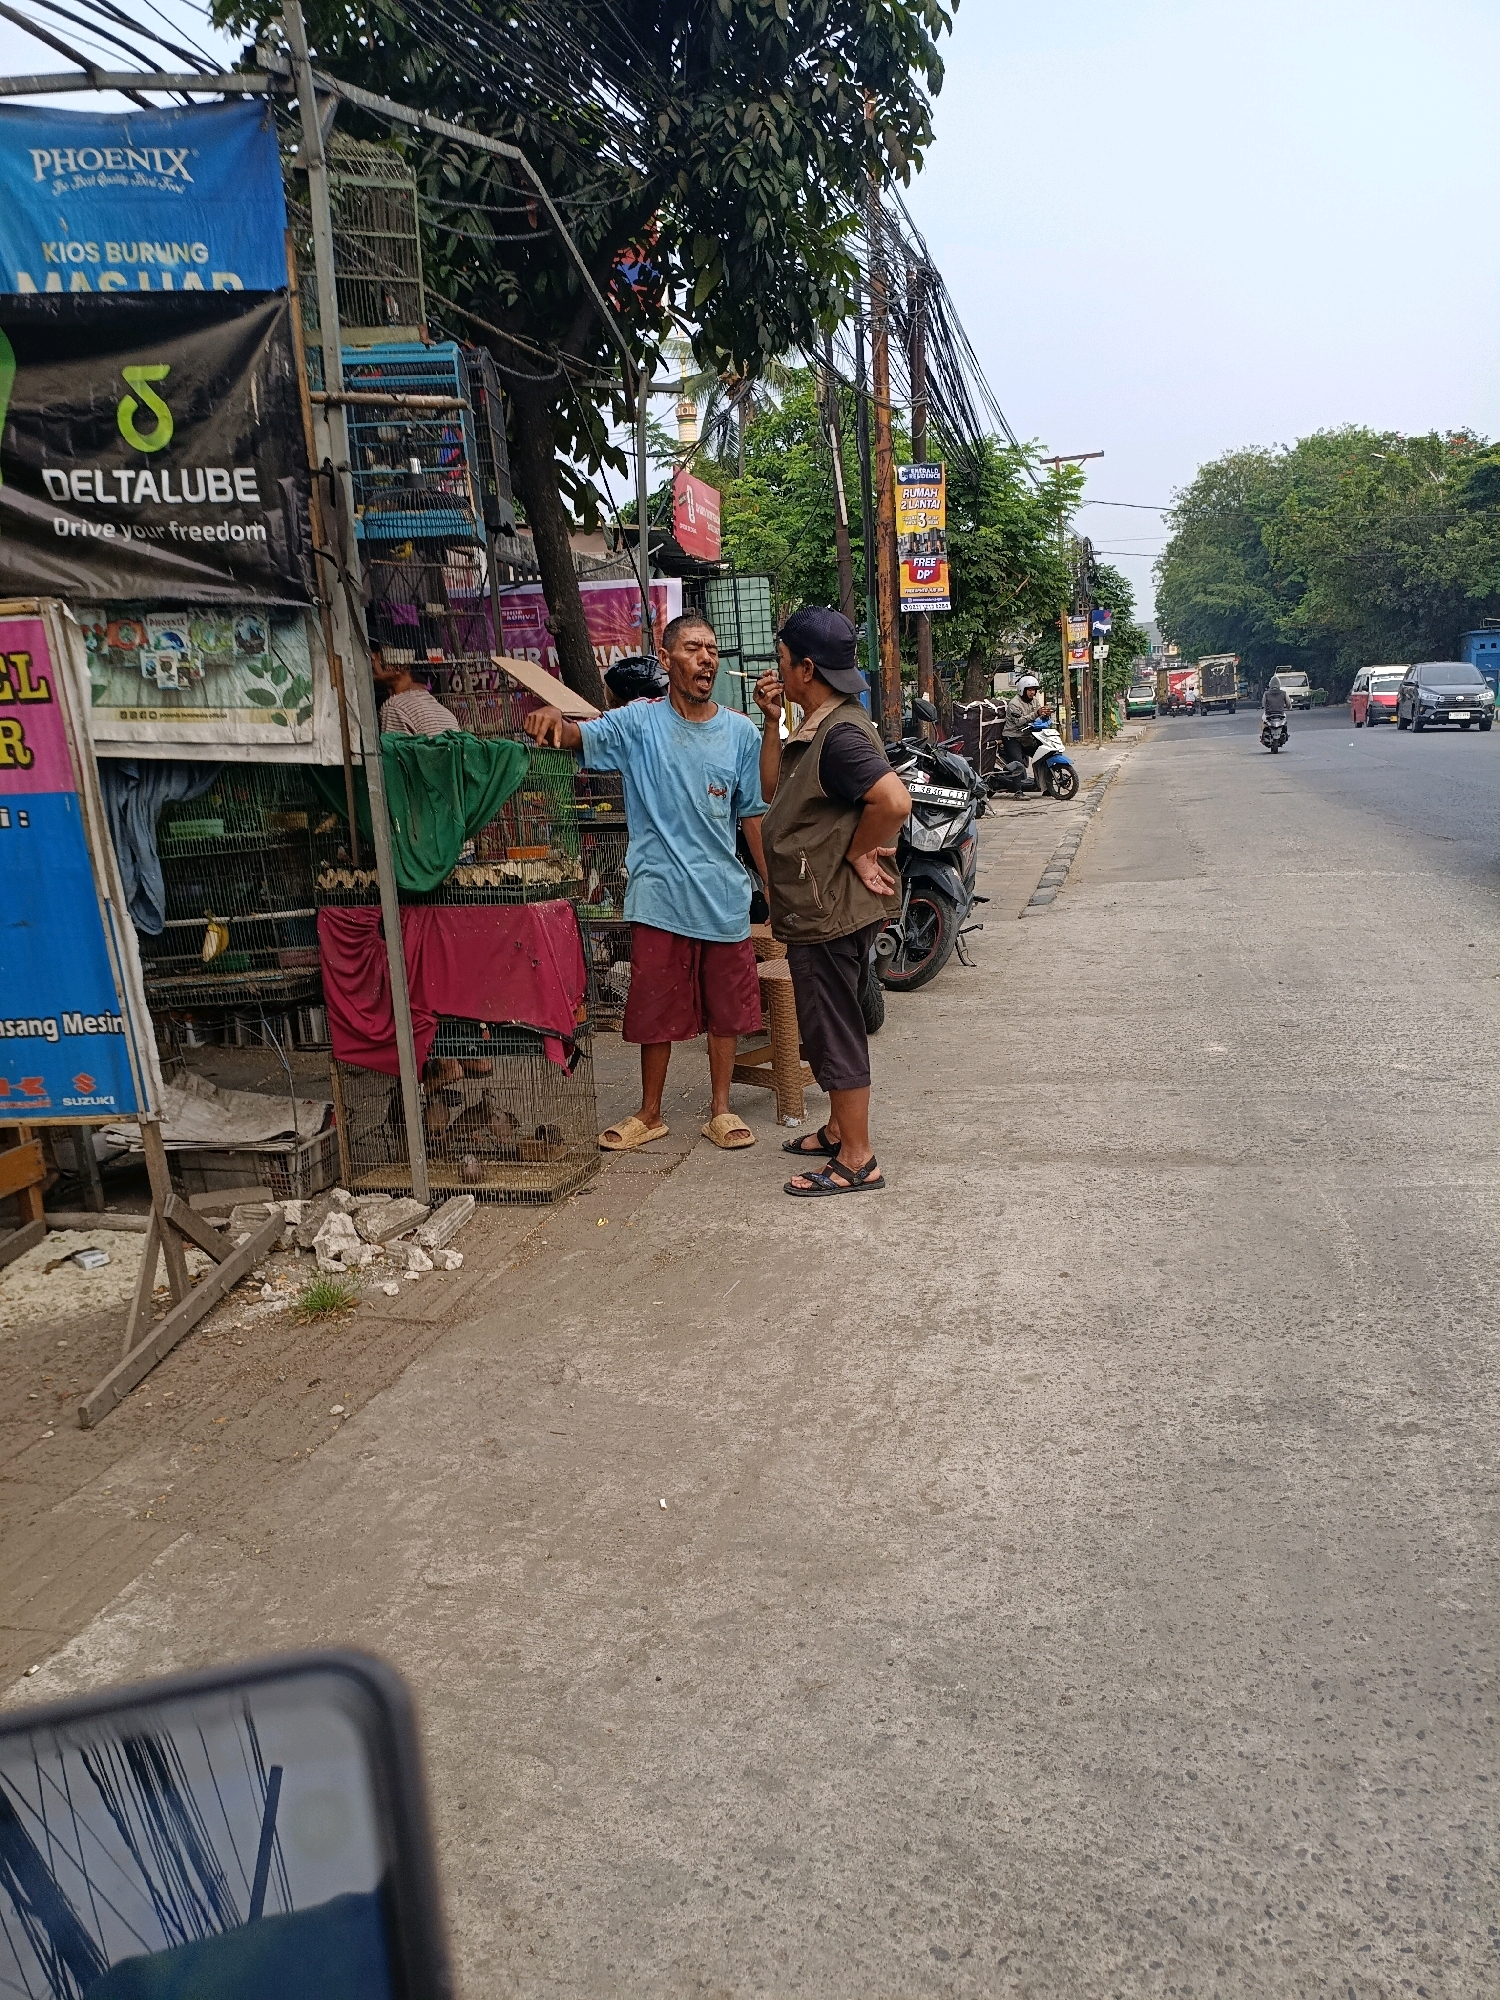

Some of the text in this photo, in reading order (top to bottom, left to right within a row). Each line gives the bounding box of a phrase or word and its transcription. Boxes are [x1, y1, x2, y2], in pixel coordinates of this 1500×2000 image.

[27, 148, 194, 183] PHOENIX
[41, 241, 209, 264] KIOS BURUNG
[42, 467, 260, 504] DELTALUBE
[903, 488, 938, 498] RUMAH
[901, 500, 941, 510] 2 LANTAI
[917, 512, 926, 527] 3
[53, 517, 266, 543] Drive your freedom
[913, 557, 936, 568] FREE
[62, 1011, 125, 1036] Mesin
[62, 1096, 115, 1107] SUZUKI
